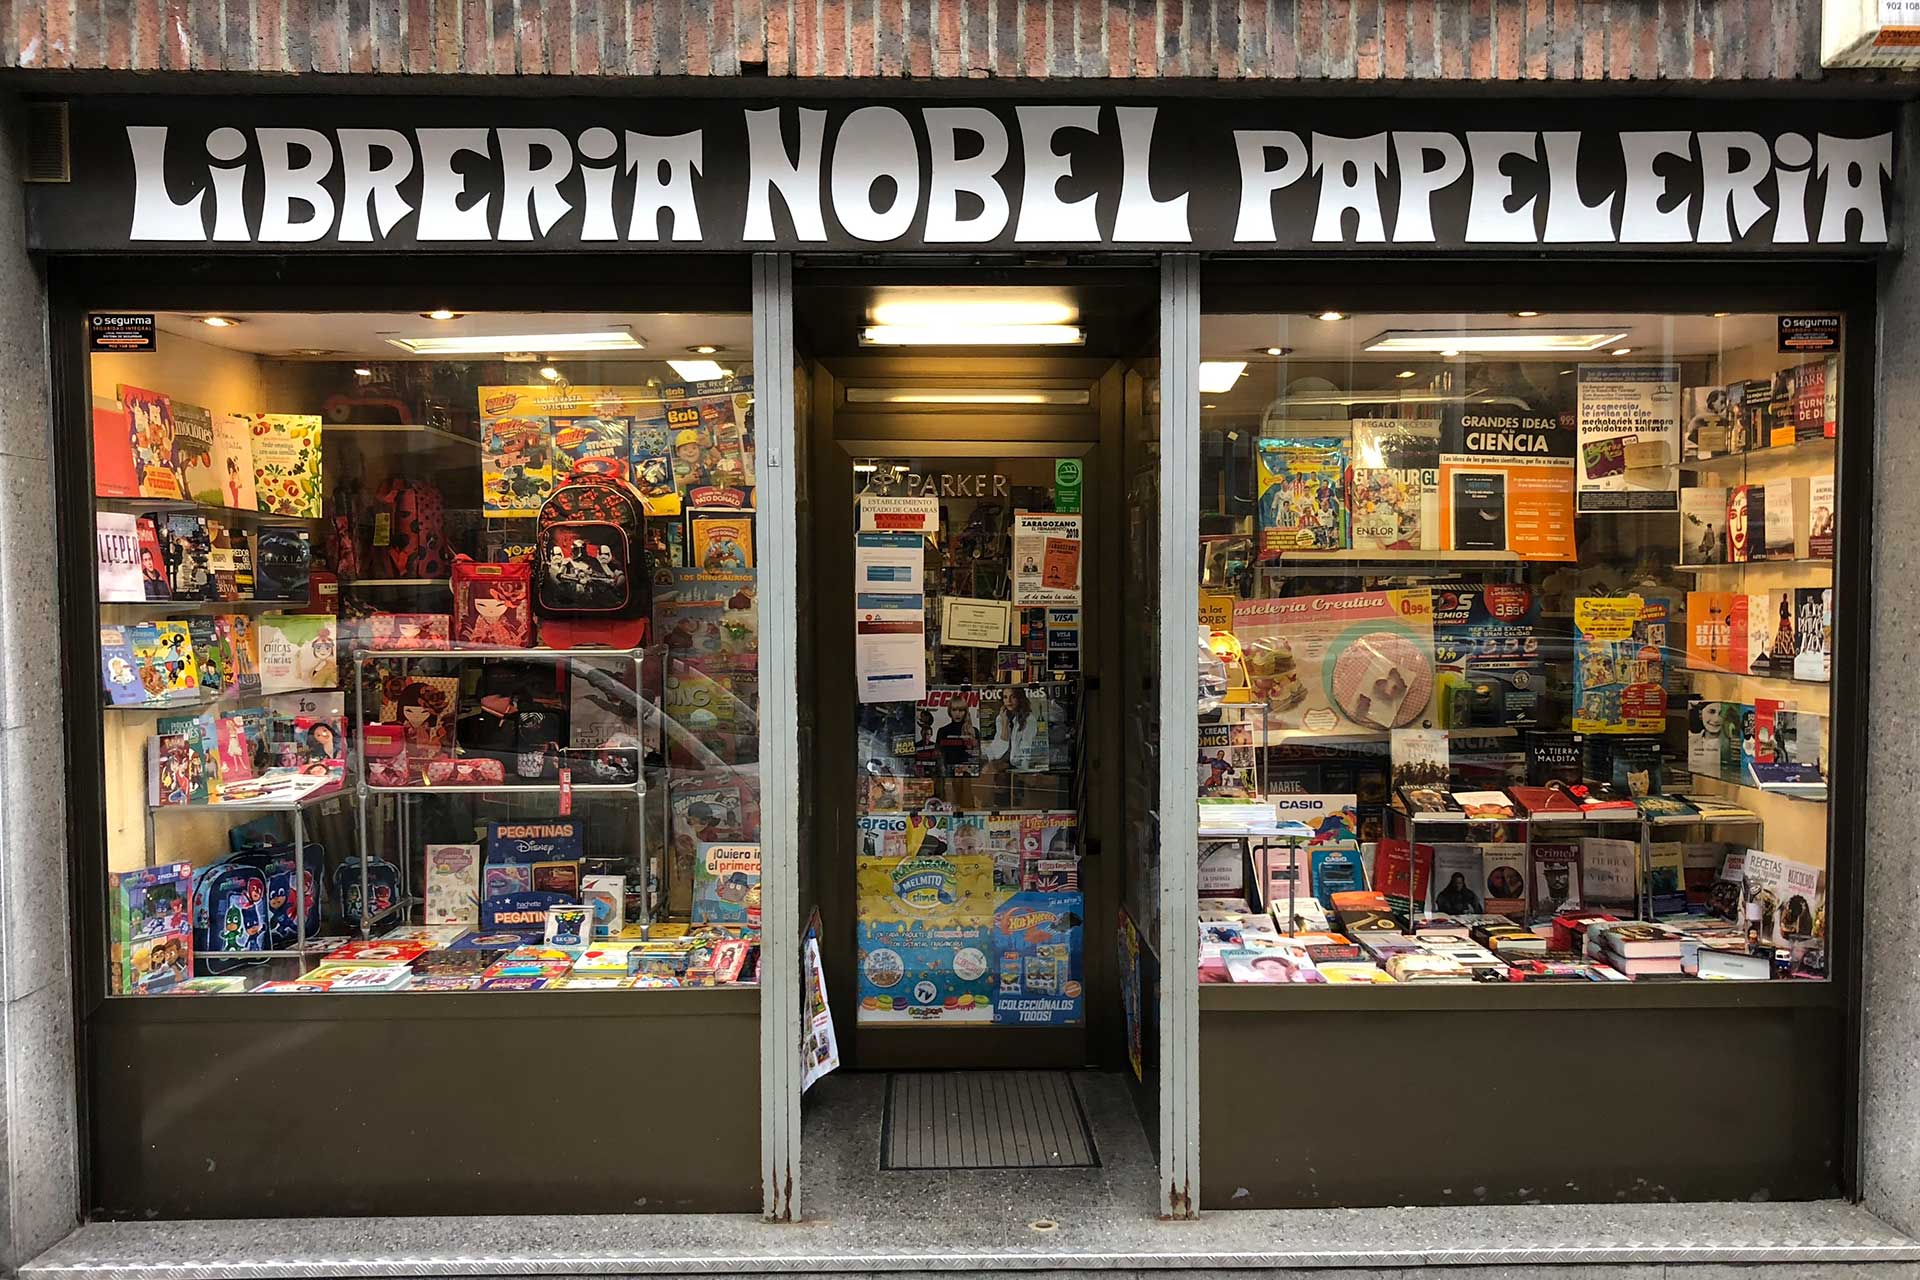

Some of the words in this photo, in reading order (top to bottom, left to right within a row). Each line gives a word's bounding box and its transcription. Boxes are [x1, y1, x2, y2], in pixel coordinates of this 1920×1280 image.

[1886, 2, 1902, 10] 902
[742, 106, 1192, 242] NOBEL
[104, 317, 152, 327] segurma
[1793, 318, 1838, 329] segurma
[1795, 373, 1825, 388] HARR
[1799, 400, 1824, 409] TURN
[668, 409, 699, 423] Bob
[1593, 409, 1621, 417] invitan
[1633, 409, 1652, 417] cine
[1800, 411, 1811, 420] DE
[1361, 421, 1396, 429] REGALO
[1461, 416, 1519, 429] GRANDES
[1522, 418, 1556, 429] IDEAS
[174, 420, 214, 447] mociones
[1466, 433, 1549, 452] CIENCIA
[1422, 470, 1439, 486] GL
[906, 474, 1008, 497] PARKER
[1356, 528, 1368, 536] EN
[1368, 527, 1394, 536] FLOR
[98, 533, 141, 565] LEEPER
[1208, 605, 1223, 614] los
[1311, 597, 1387, 611] Creativa
[1053, 614, 1074, 622] VISA
[1432, 611, 1470, 619] REMIOS
[1695, 624, 1731, 635] HAM
[1695, 635, 1729, 646] BRE
[917, 690, 980, 707] ACCIN
[1204, 727, 1228, 735] CREAR
[1199, 735, 1229, 746] OMICS
[1534, 746, 1546, 755] LA
[1548, 747, 1581, 755] TIERRA
[1536, 754, 1577, 763] MALDITA
[1269, 781, 1301, 793] MARTE
[1279, 800, 1323, 809] CASIO
[1050, 818, 1076, 828] Englis
[497, 825, 573, 838] PEGATINAS
[514, 840, 555, 854] Disney
[714, 848, 751, 859] ¡Quiero
[708, 860, 718, 870] el
[1750, 855, 1782, 873] RECETAS
[902, 874, 942, 891] MELMITO
[494, 911, 547, 923] PEGATIN
[1007, 915, 1027, 931] HOT
[917, 988, 933, 1000] TV
